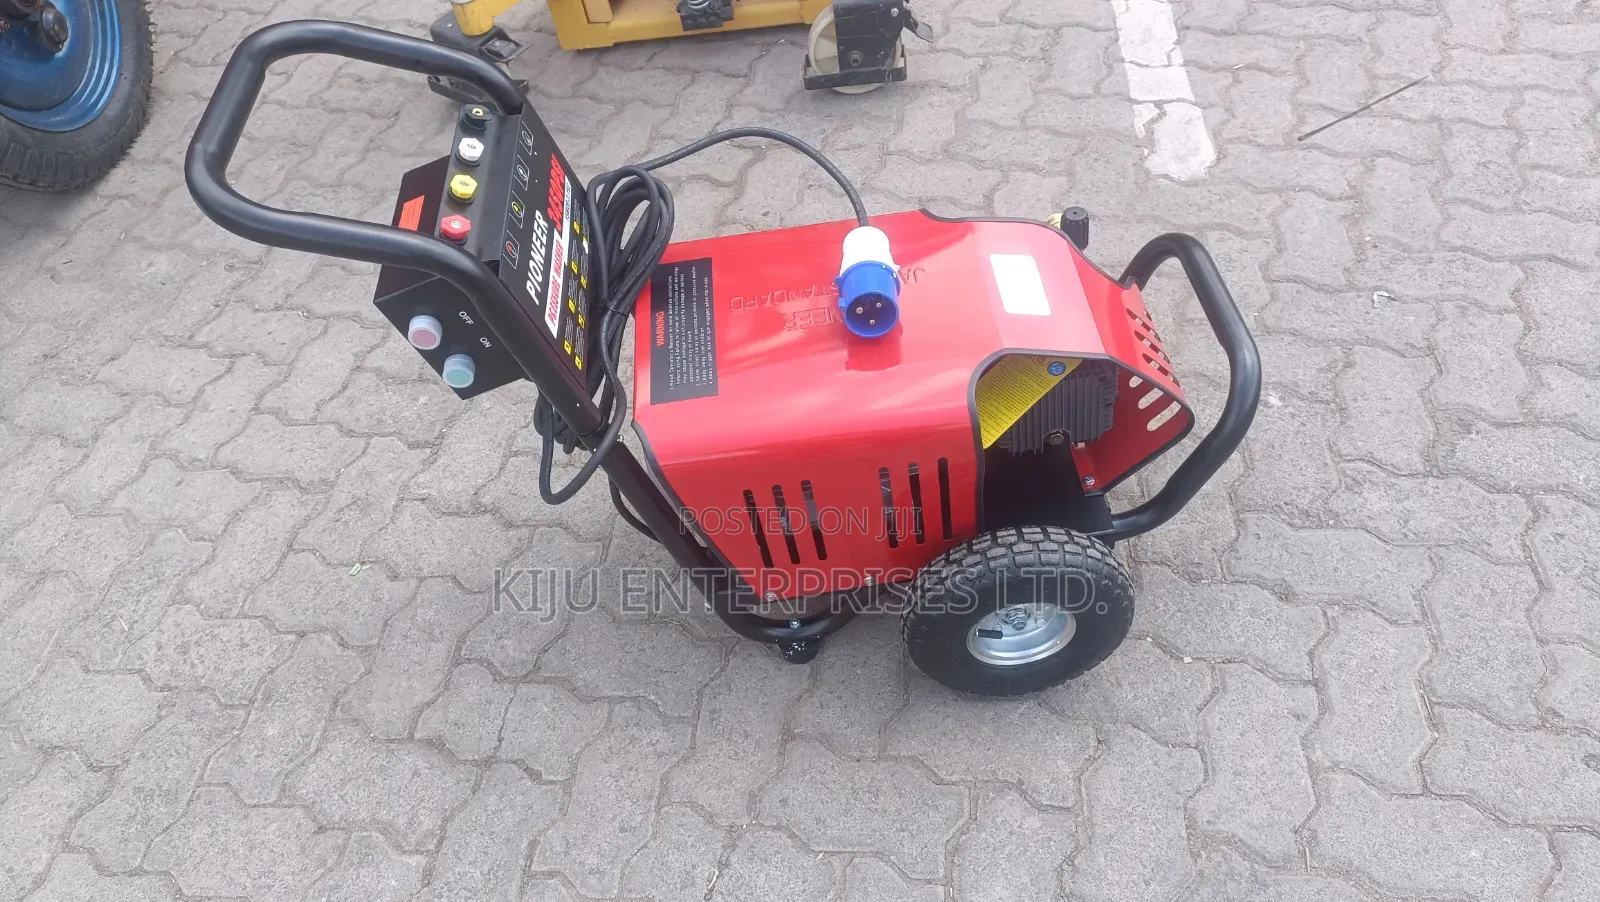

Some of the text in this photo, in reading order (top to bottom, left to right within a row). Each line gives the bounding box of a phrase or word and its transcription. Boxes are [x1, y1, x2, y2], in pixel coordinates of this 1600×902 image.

[526, 210, 548, 305] PIONEER
[458, 311, 474, 326] OFF
[656, 311, 665, 346] WARNING
[479, 337, 492, 348] ON
